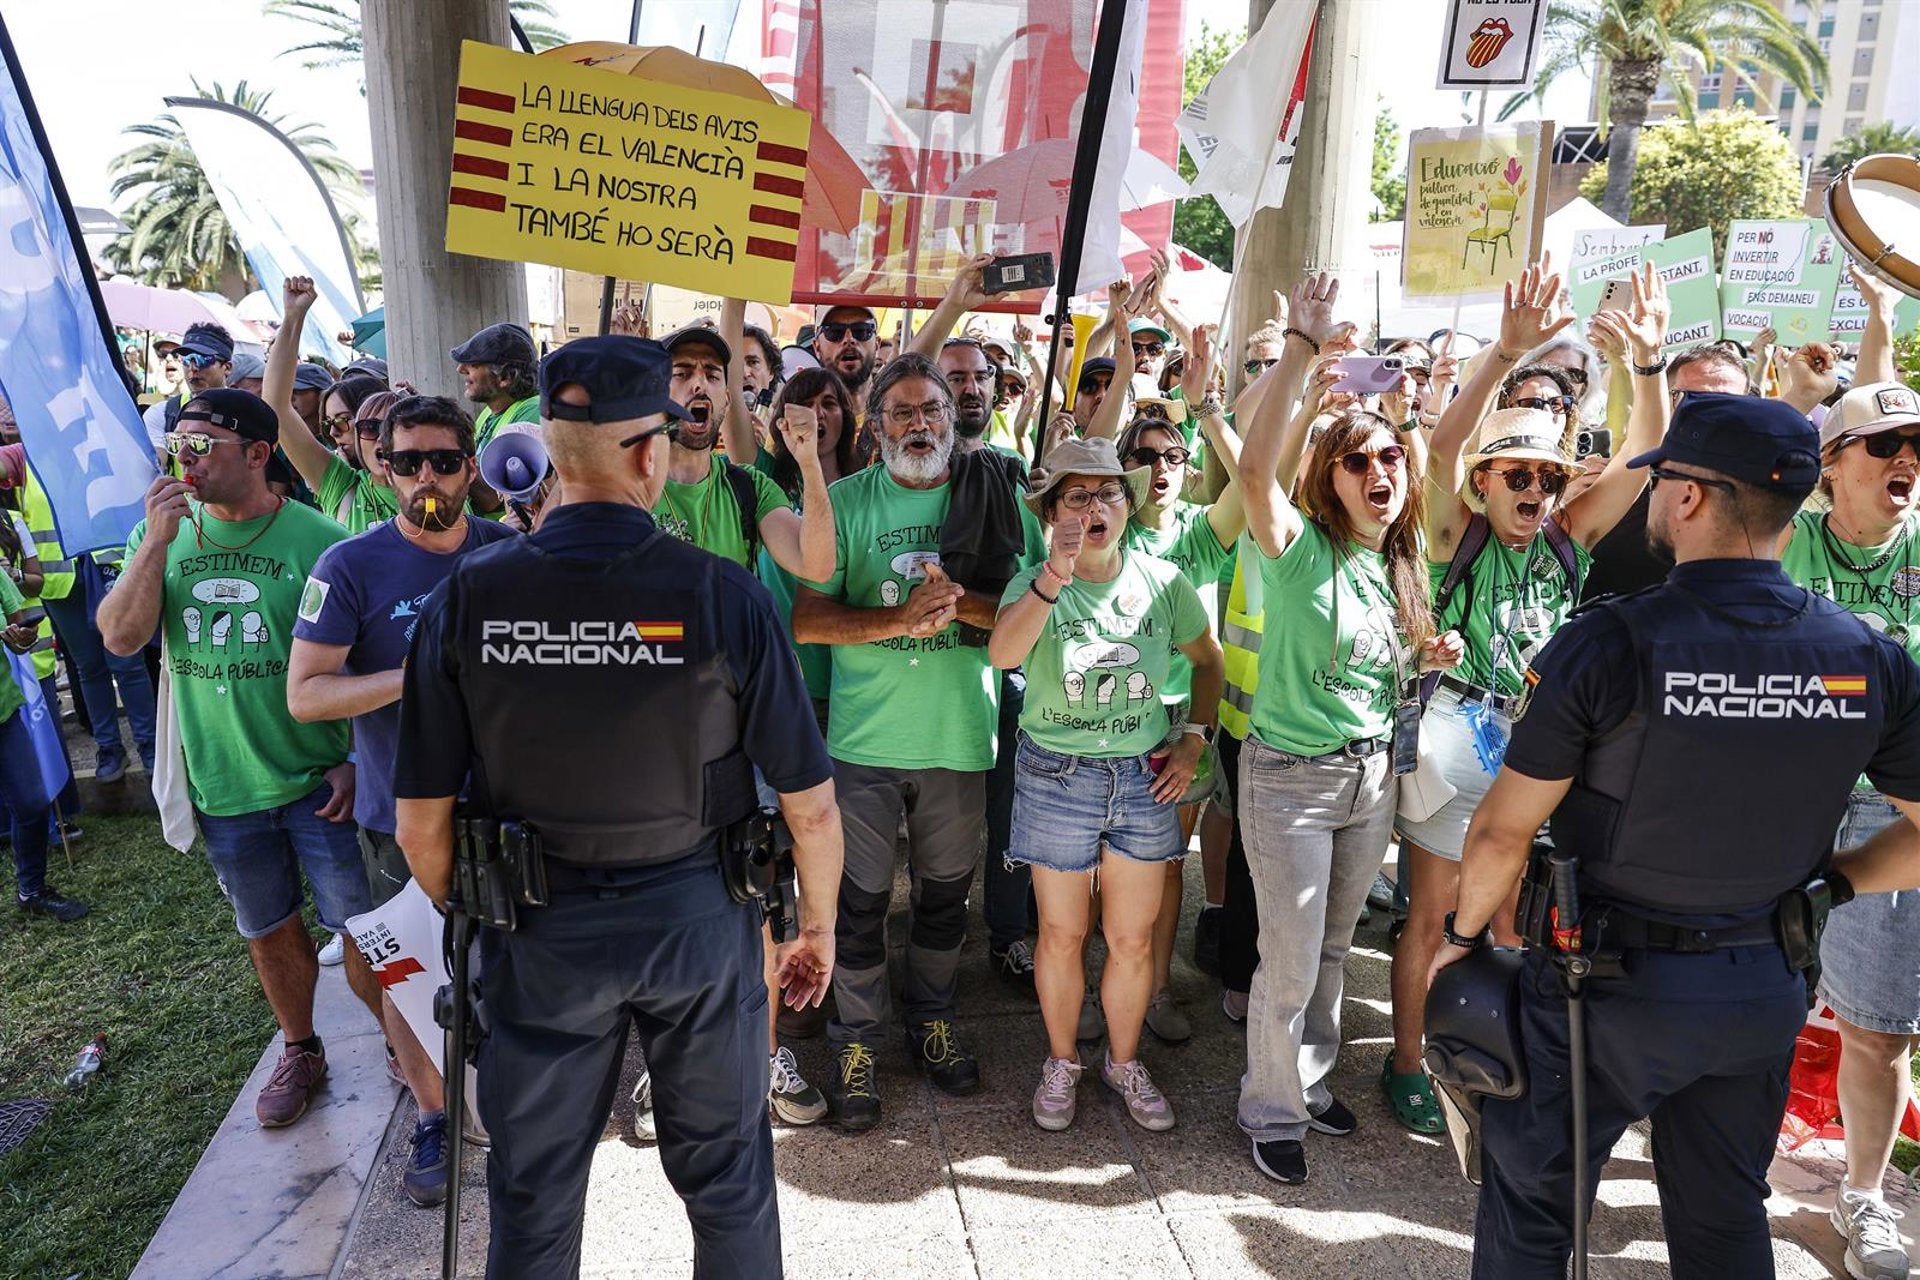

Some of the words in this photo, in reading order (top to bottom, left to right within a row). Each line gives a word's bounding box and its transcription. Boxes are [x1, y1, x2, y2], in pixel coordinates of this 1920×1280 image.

[522, 82, 552, 110] LA
[559, 89, 648, 126] LLENGUA
[653, 106, 698, 132] DELS
[704, 115, 759, 144] AVIS
[522, 123, 570, 151] ERA
[579, 133, 613, 157] EL
[621, 137, 745, 180] VALENCIÀ
[1421, 157, 1500, 182] Educació
[517, 163, 535, 186] I
[554, 167, 589, 195] LA
[597, 175, 697, 210] NOSTRA
[510, 203, 610, 244] TAMBÉ
[617, 220, 653, 247] HO
[657, 224, 734, 265] SERÀ
[1737, 232, 1756, 243] PER
[1732, 251, 1779, 262] INVERTIR
[1583, 268, 1598, 280] LA
[1730, 270, 1743, 280] EN
[1748, 292, 1766, 303] ENS
[1768, 293, 1815, 304] DEMANEU
[876, 526, 941, 553] ESTIM
[177, 553, 286, 580] ESTIMEM
[482, 620, 643, 641] POLICIA
[482, 643, 684, 665] NACIONAL
[1665, 672, 1828, 696] POLICIA
[1664, 695, 1866, 719] NACIONAL
